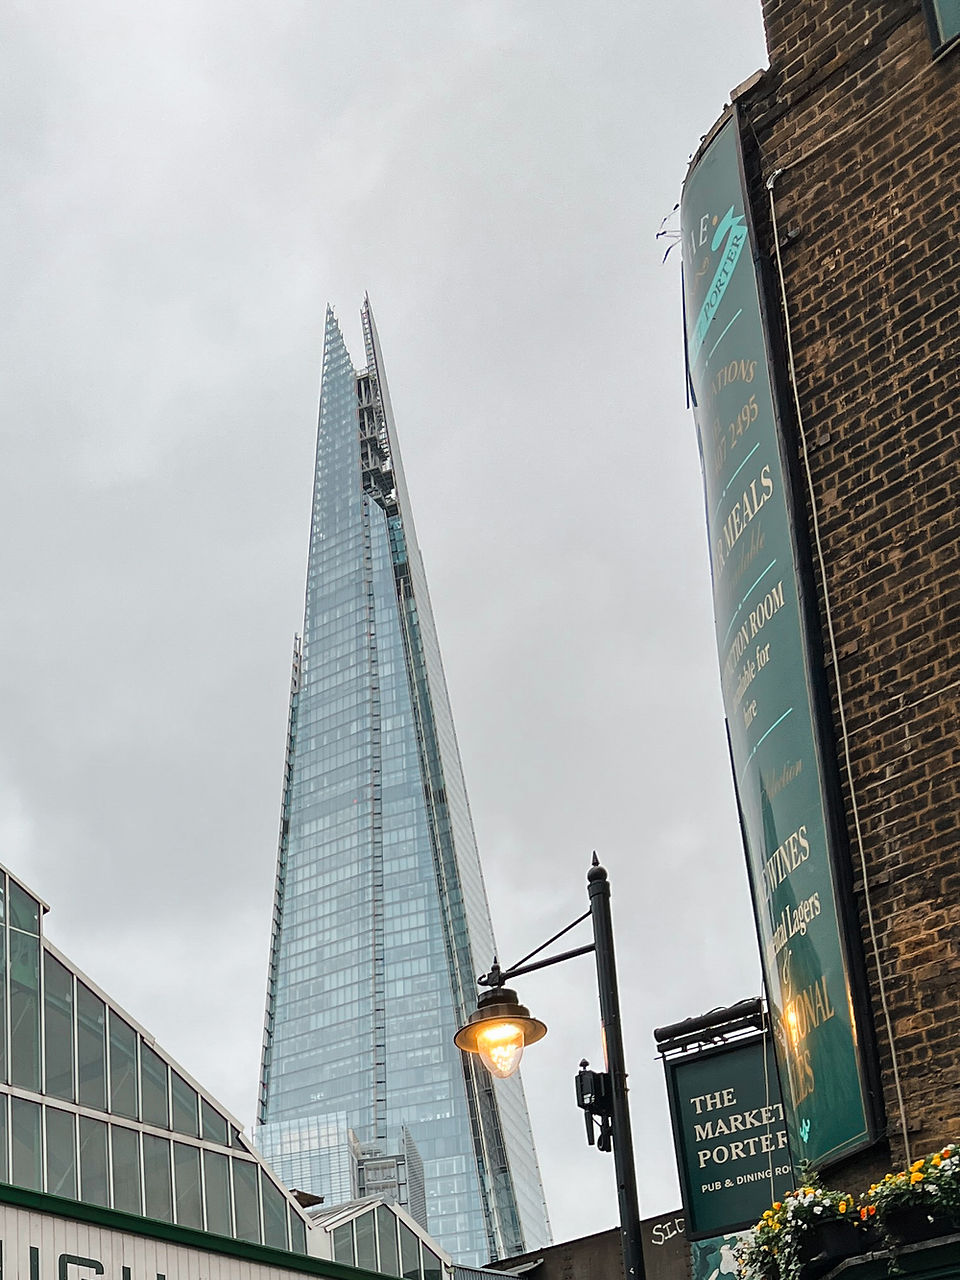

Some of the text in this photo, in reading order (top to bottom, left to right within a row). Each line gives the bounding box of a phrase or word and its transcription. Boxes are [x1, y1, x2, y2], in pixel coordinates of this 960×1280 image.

[703, 234, 743, 321] PORTER
[728, 393, 759, 449] 2495
[722, 464, 774, 559] MEALS
[749, 579, 785, 640] ROOM
[756, 642, 771, 673] for
[766, 823, 811, 894] WINES
[786, 891, 822, 937] Lagers
[690, 1087, 737, 1115] THE
[693, 1103, 785, 1142] MARKET
[701, 1165, 793, 1193] PUB & DINING RO
